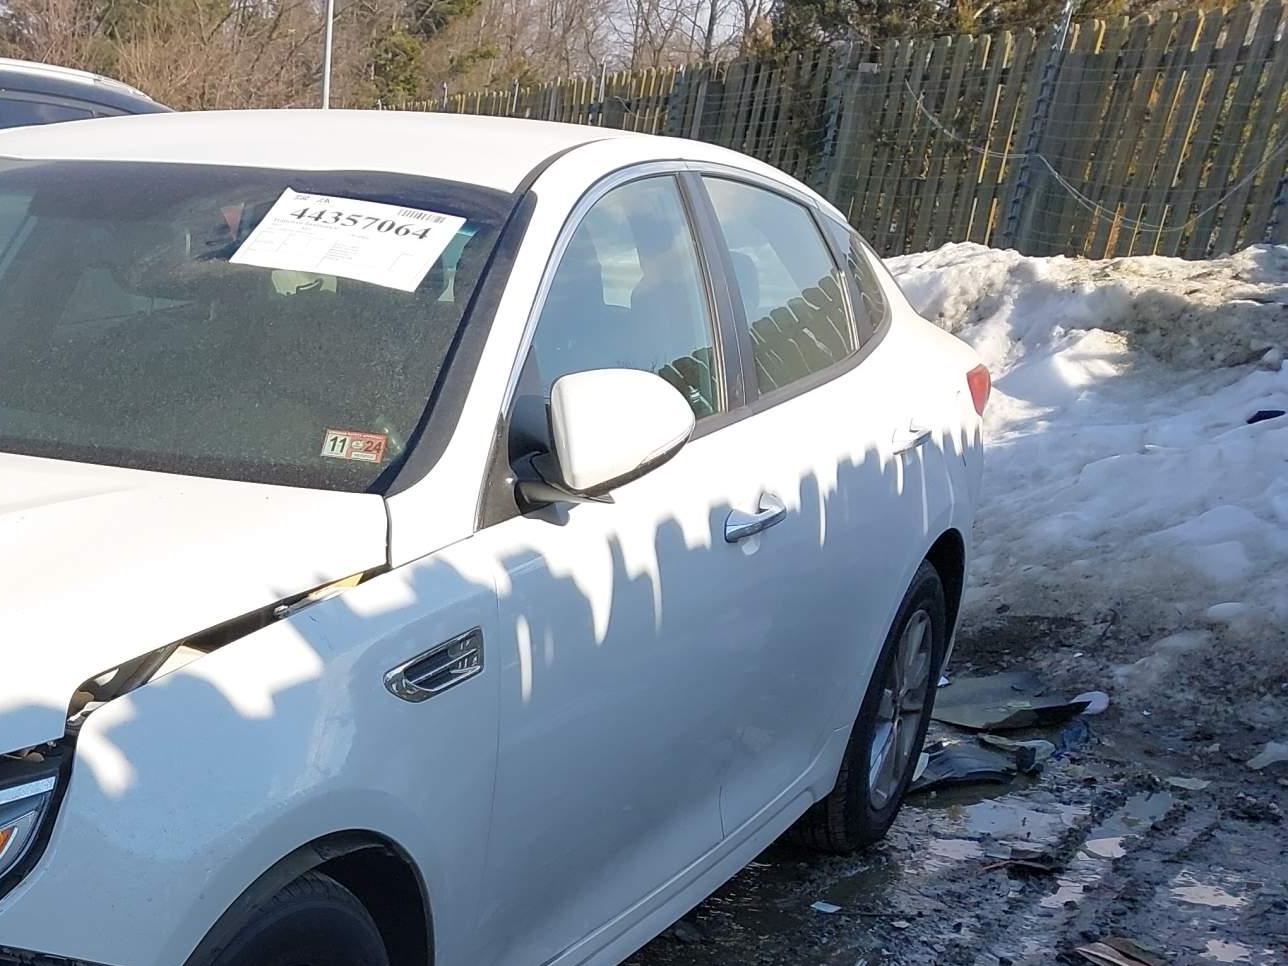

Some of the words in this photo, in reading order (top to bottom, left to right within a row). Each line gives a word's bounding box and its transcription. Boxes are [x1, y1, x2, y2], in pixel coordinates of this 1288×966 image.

[290, 207, 432, 240] 44357064
[329, 436, 347, 453] 11
[363, 440, 382, 454] 24
